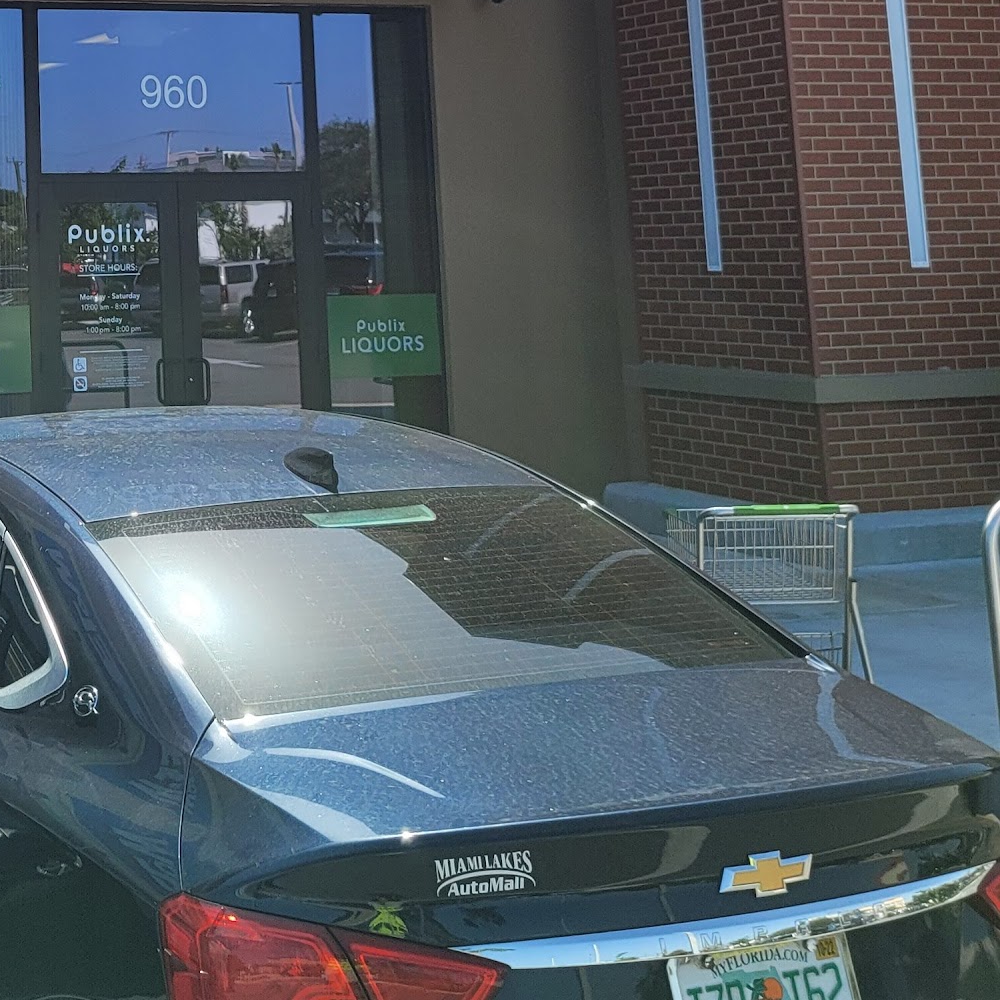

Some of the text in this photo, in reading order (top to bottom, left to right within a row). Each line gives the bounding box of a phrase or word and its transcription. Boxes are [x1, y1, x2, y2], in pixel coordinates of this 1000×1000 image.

[140, 74, 208, 109] 960
[68, 223, 145, 244] Publix
[79, 244, 135, 254] LIQUORS
[79, 263, 106, 273] STORE
[111, 292, 140, 300] Saturday
[356, 319, 405, 333] Publix
[341, 335, 425, 354] LIQUORS
[434, 850, 534, 884] MIAMI LAKES
[447, 876, 526, 897] AutoMall
